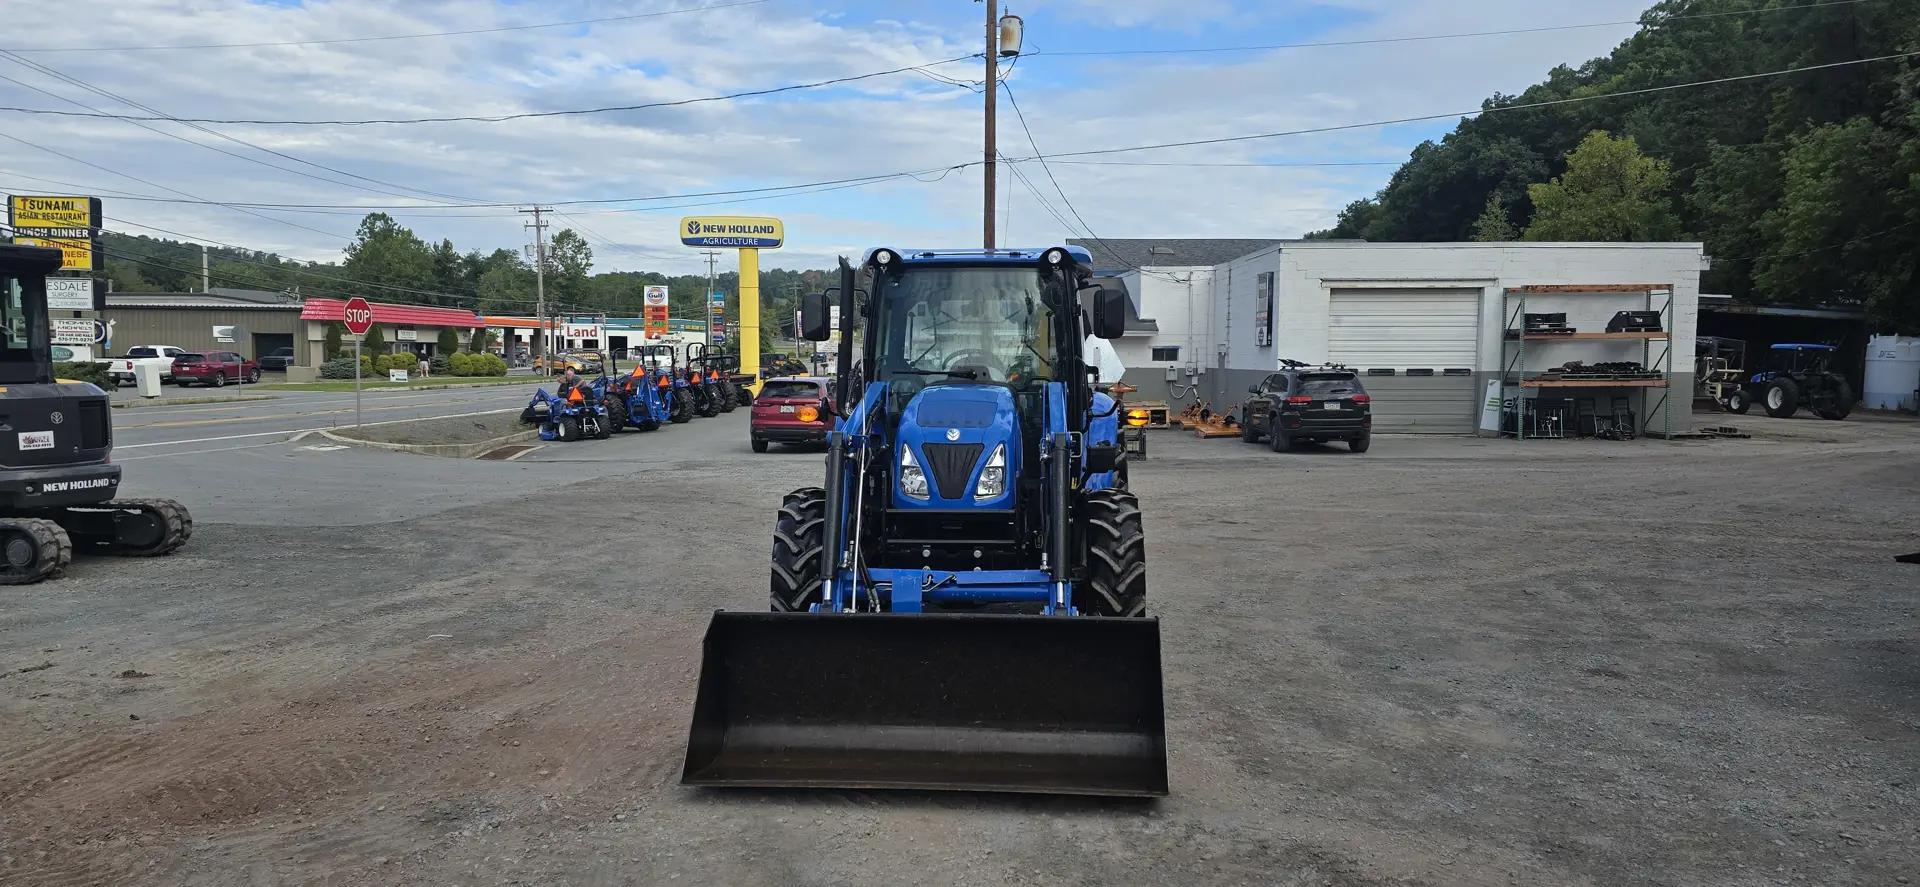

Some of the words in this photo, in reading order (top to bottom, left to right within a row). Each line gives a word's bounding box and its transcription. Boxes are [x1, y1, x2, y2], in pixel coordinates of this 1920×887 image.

[21, 198, 74, 211] TSUNAMI
[18, 212, 38, 220] ASIAN
[42, 212, 87, 221] RESTAURANT
[14, 227, 48, 237] LUNCH
[51, 228, 90, 238] DINNER
[703, 225, 726, 233] NEW
[728, 225, 775, 234] HOLLAND
[41, 241, 86, 249] CHINESE
[702, 237, 758, 245] AGRICULTURE
[46, 281, 88, 292] ESDALE
[346, 308, 370, 323] STOP
[566, 325, 598, 337] Land
[43, 482, 68, 492] NEW
[70, 478, 109, 490] HOLLAND
